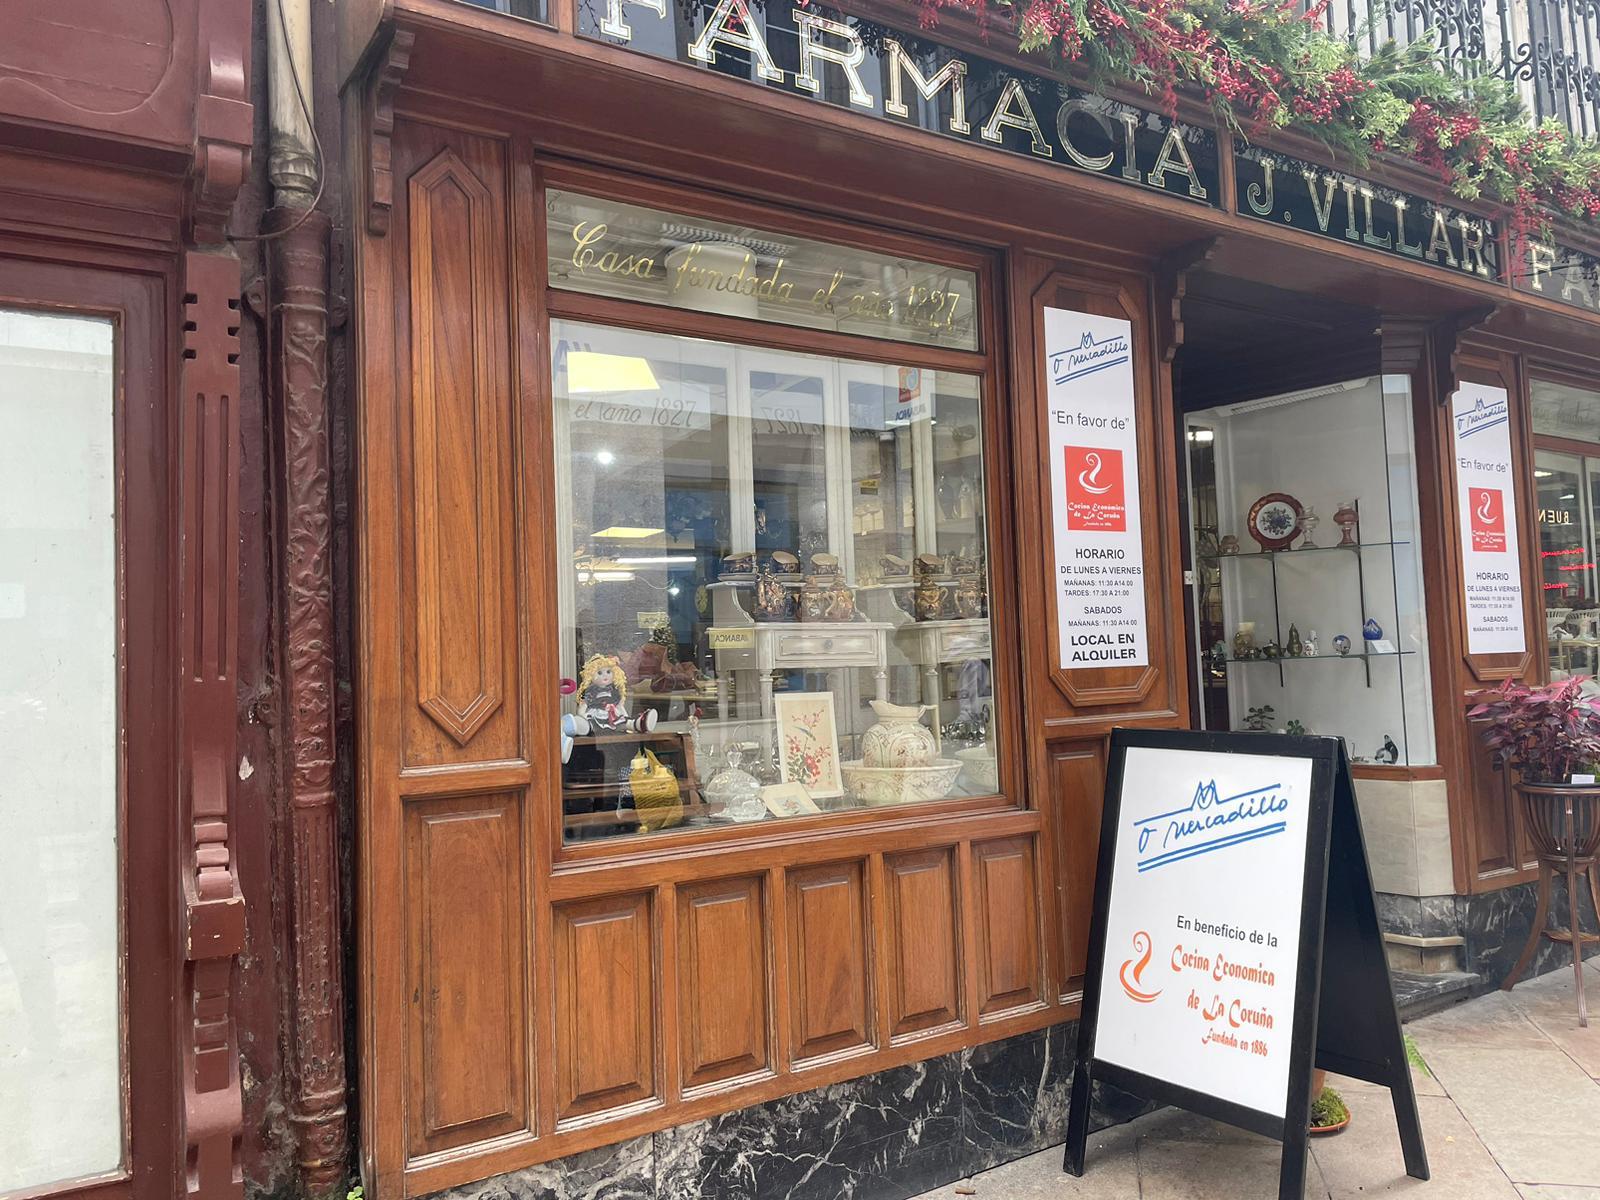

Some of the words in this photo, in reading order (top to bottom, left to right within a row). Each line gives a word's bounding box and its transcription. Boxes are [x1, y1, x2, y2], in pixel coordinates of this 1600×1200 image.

[1247, 157, 1292, 222] J.
[1302, 170, 1489, 277] VILLAR
[572, 220, 656, 278] Casa
[675, 243, 794, 302] fundada
[811, 267, 844, 312] el
[849, 290, 895, 318] año
[1068, 342, 1128, 371] Mercadillo
[650, 397, 697, 428] 1827
[1077, 413, 1107, 429] favor
[1474, 459, 1495, 471] favor
[1075, 548, 1125, 559] HORARIO
[1060, 565, 1072, 574] DE
[1074, 566, 1100, 574] LUNES
[1102, 566, 1108, 574] A
[1109, 567, 1141, 575] VIERNES
[1476, 572, 1509, 580] HORARIO
[1498, 585, 1520, 593] VIERNES
[1084, 606, 1122, 615] SABADOS
[1483, 615, 1509, 623] SABADOS
[1071, 634, 1114, 646] LOCAL
[1117, 633, 1135, 644] EN
[1072, 648, 1137, 662] ALQUILER
[1138, 827, 1157, 854] O
[1163, 795, 1288, 849] Mercadillo
[1176, 914, 1191, 930] En
[1194, 918, 1246, 941] beneficio
[1249, 930, 1264, 945] de
[1267, 932, 1278, 948] la
[1170, 944, 1210, 972] Cocina
[1187, 988, 1200, 1010] de
[1202, 994, 1225, 1022] La
[1228, 999, 1274, 1030] Coruña
[1201, 1027, 1238, 1048] Fundada
[1240, 1040, 1249, 1051] en
[1251, 1039, 1268, 1057] 1886
